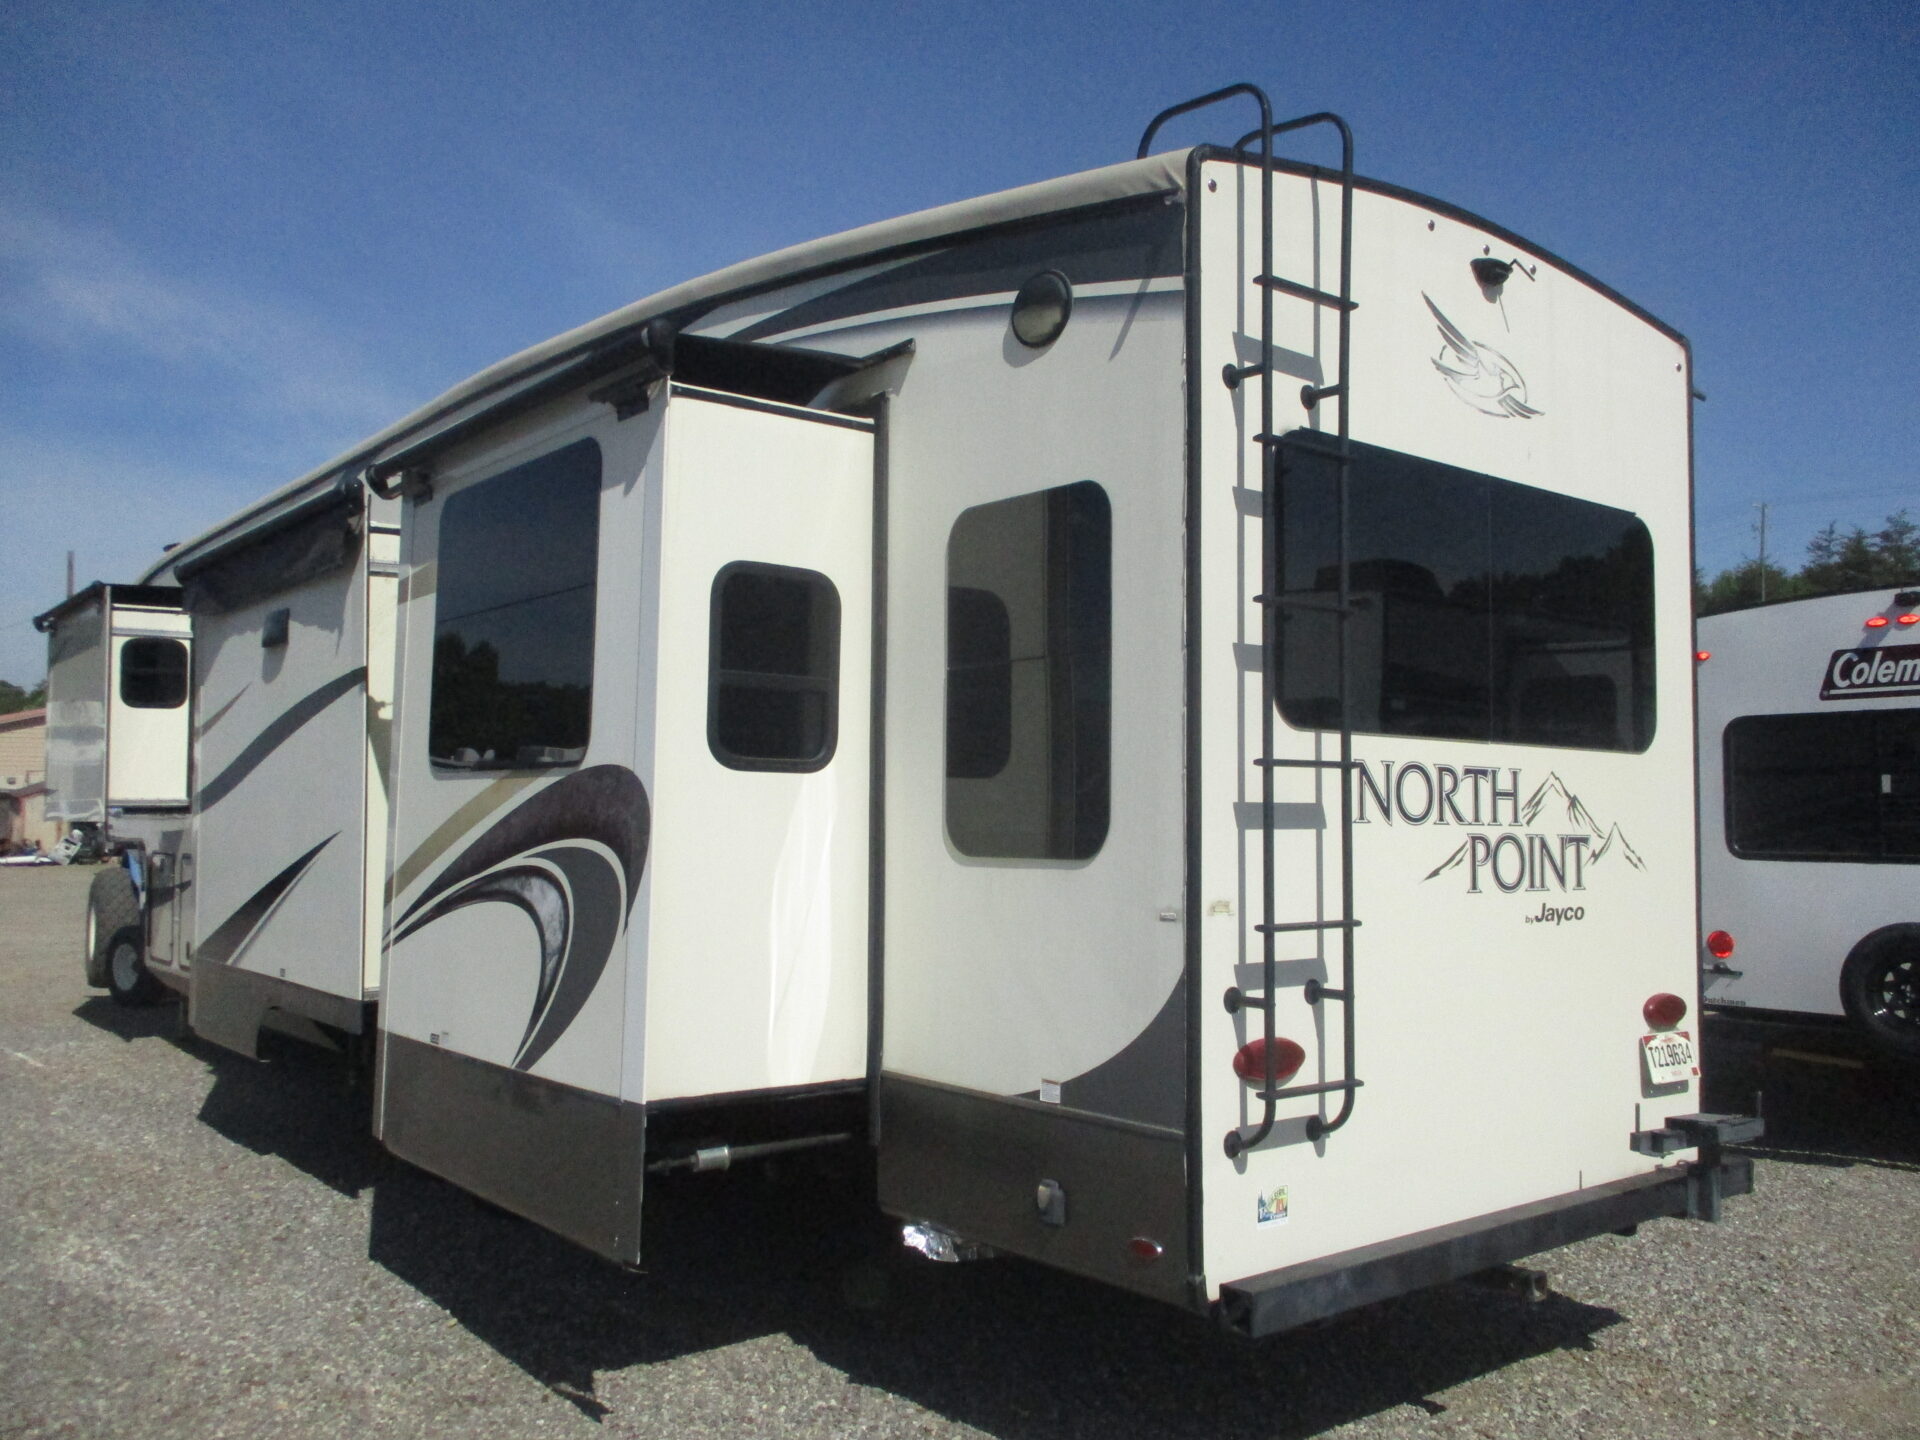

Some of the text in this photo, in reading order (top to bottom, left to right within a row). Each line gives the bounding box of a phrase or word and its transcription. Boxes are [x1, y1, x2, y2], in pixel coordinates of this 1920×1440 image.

[1833, 651, 1920, 688] Colem
[1353, 758, 1524, 827] NORTH
[1467, 832, 1591, 894] POINT
[1534, 902, 1585, 926] Jayco
[1647, 1042, 1693, 1069] T219634
